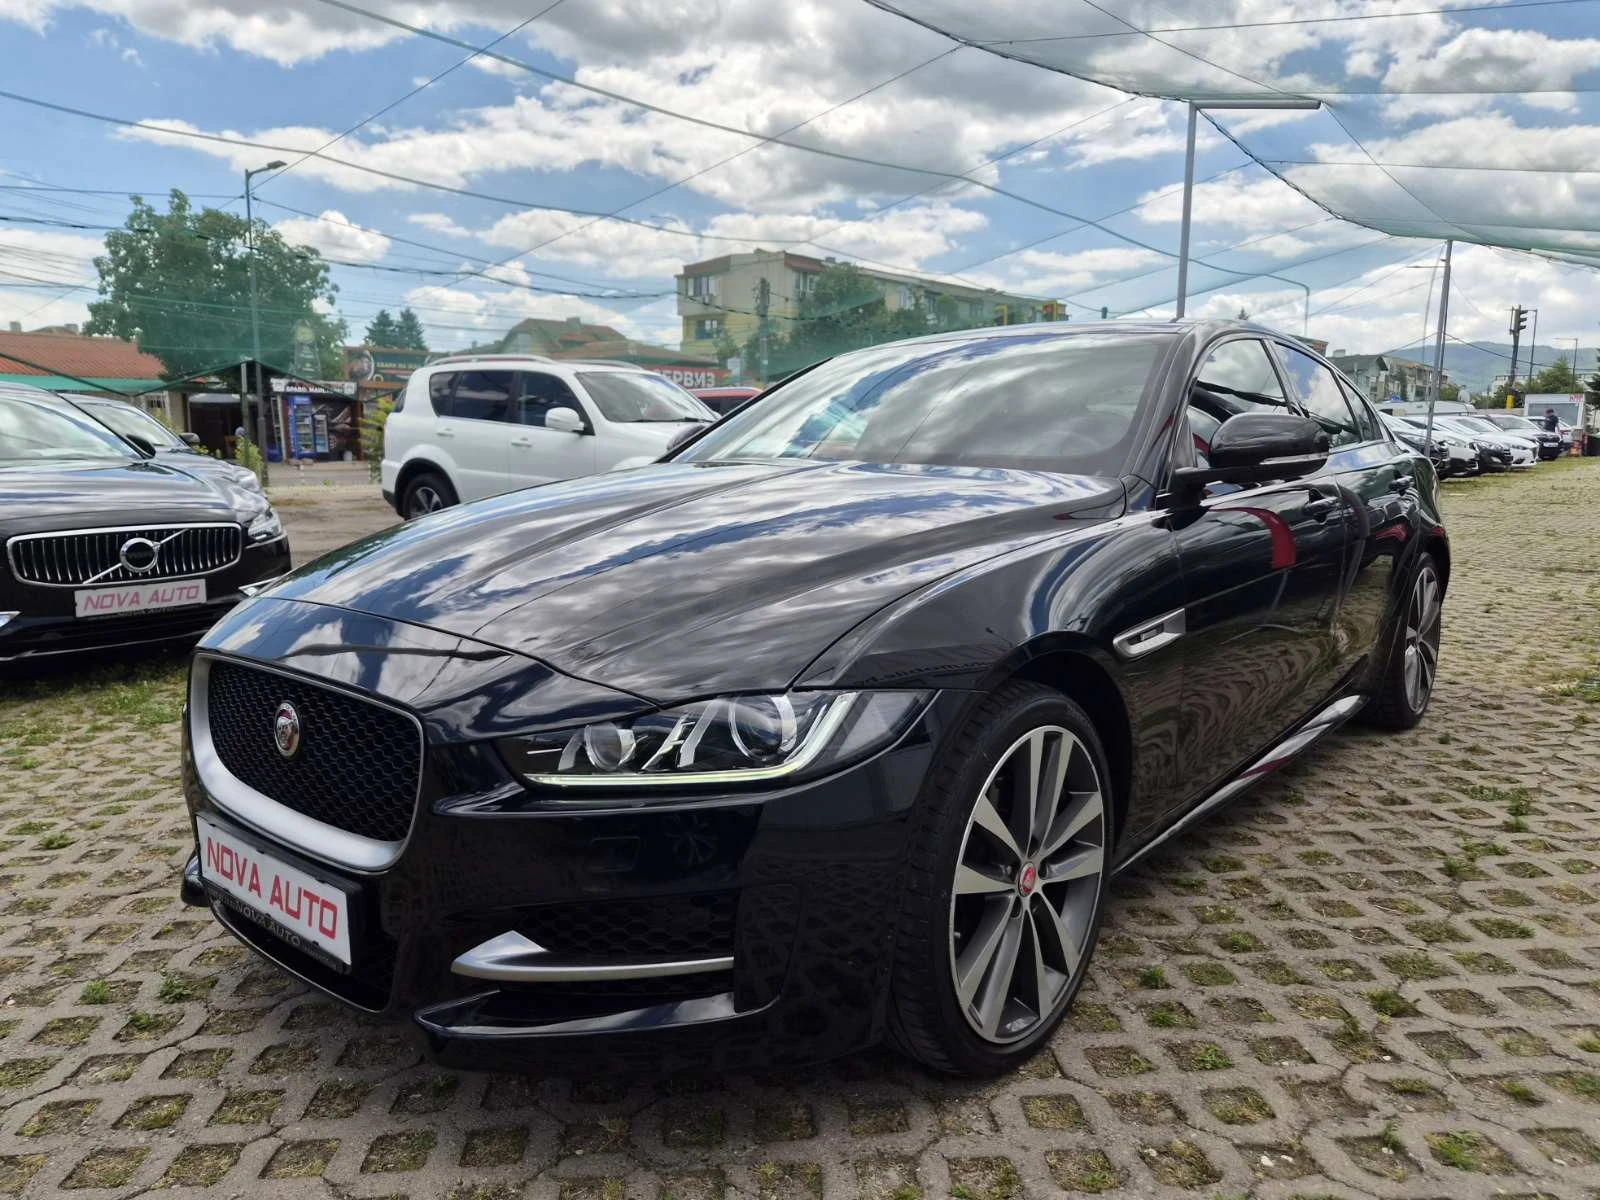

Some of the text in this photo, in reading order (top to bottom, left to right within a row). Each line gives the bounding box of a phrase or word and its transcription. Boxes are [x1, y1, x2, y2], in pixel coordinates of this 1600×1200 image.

[654, 369, 716, 388] ЕРВИЗ
[84, 585, 200, 610] NOVA AUTO
[207, 836, 338, 940] NOVA AUTO
[236, 904, 301, 945] NOVA AUTO
